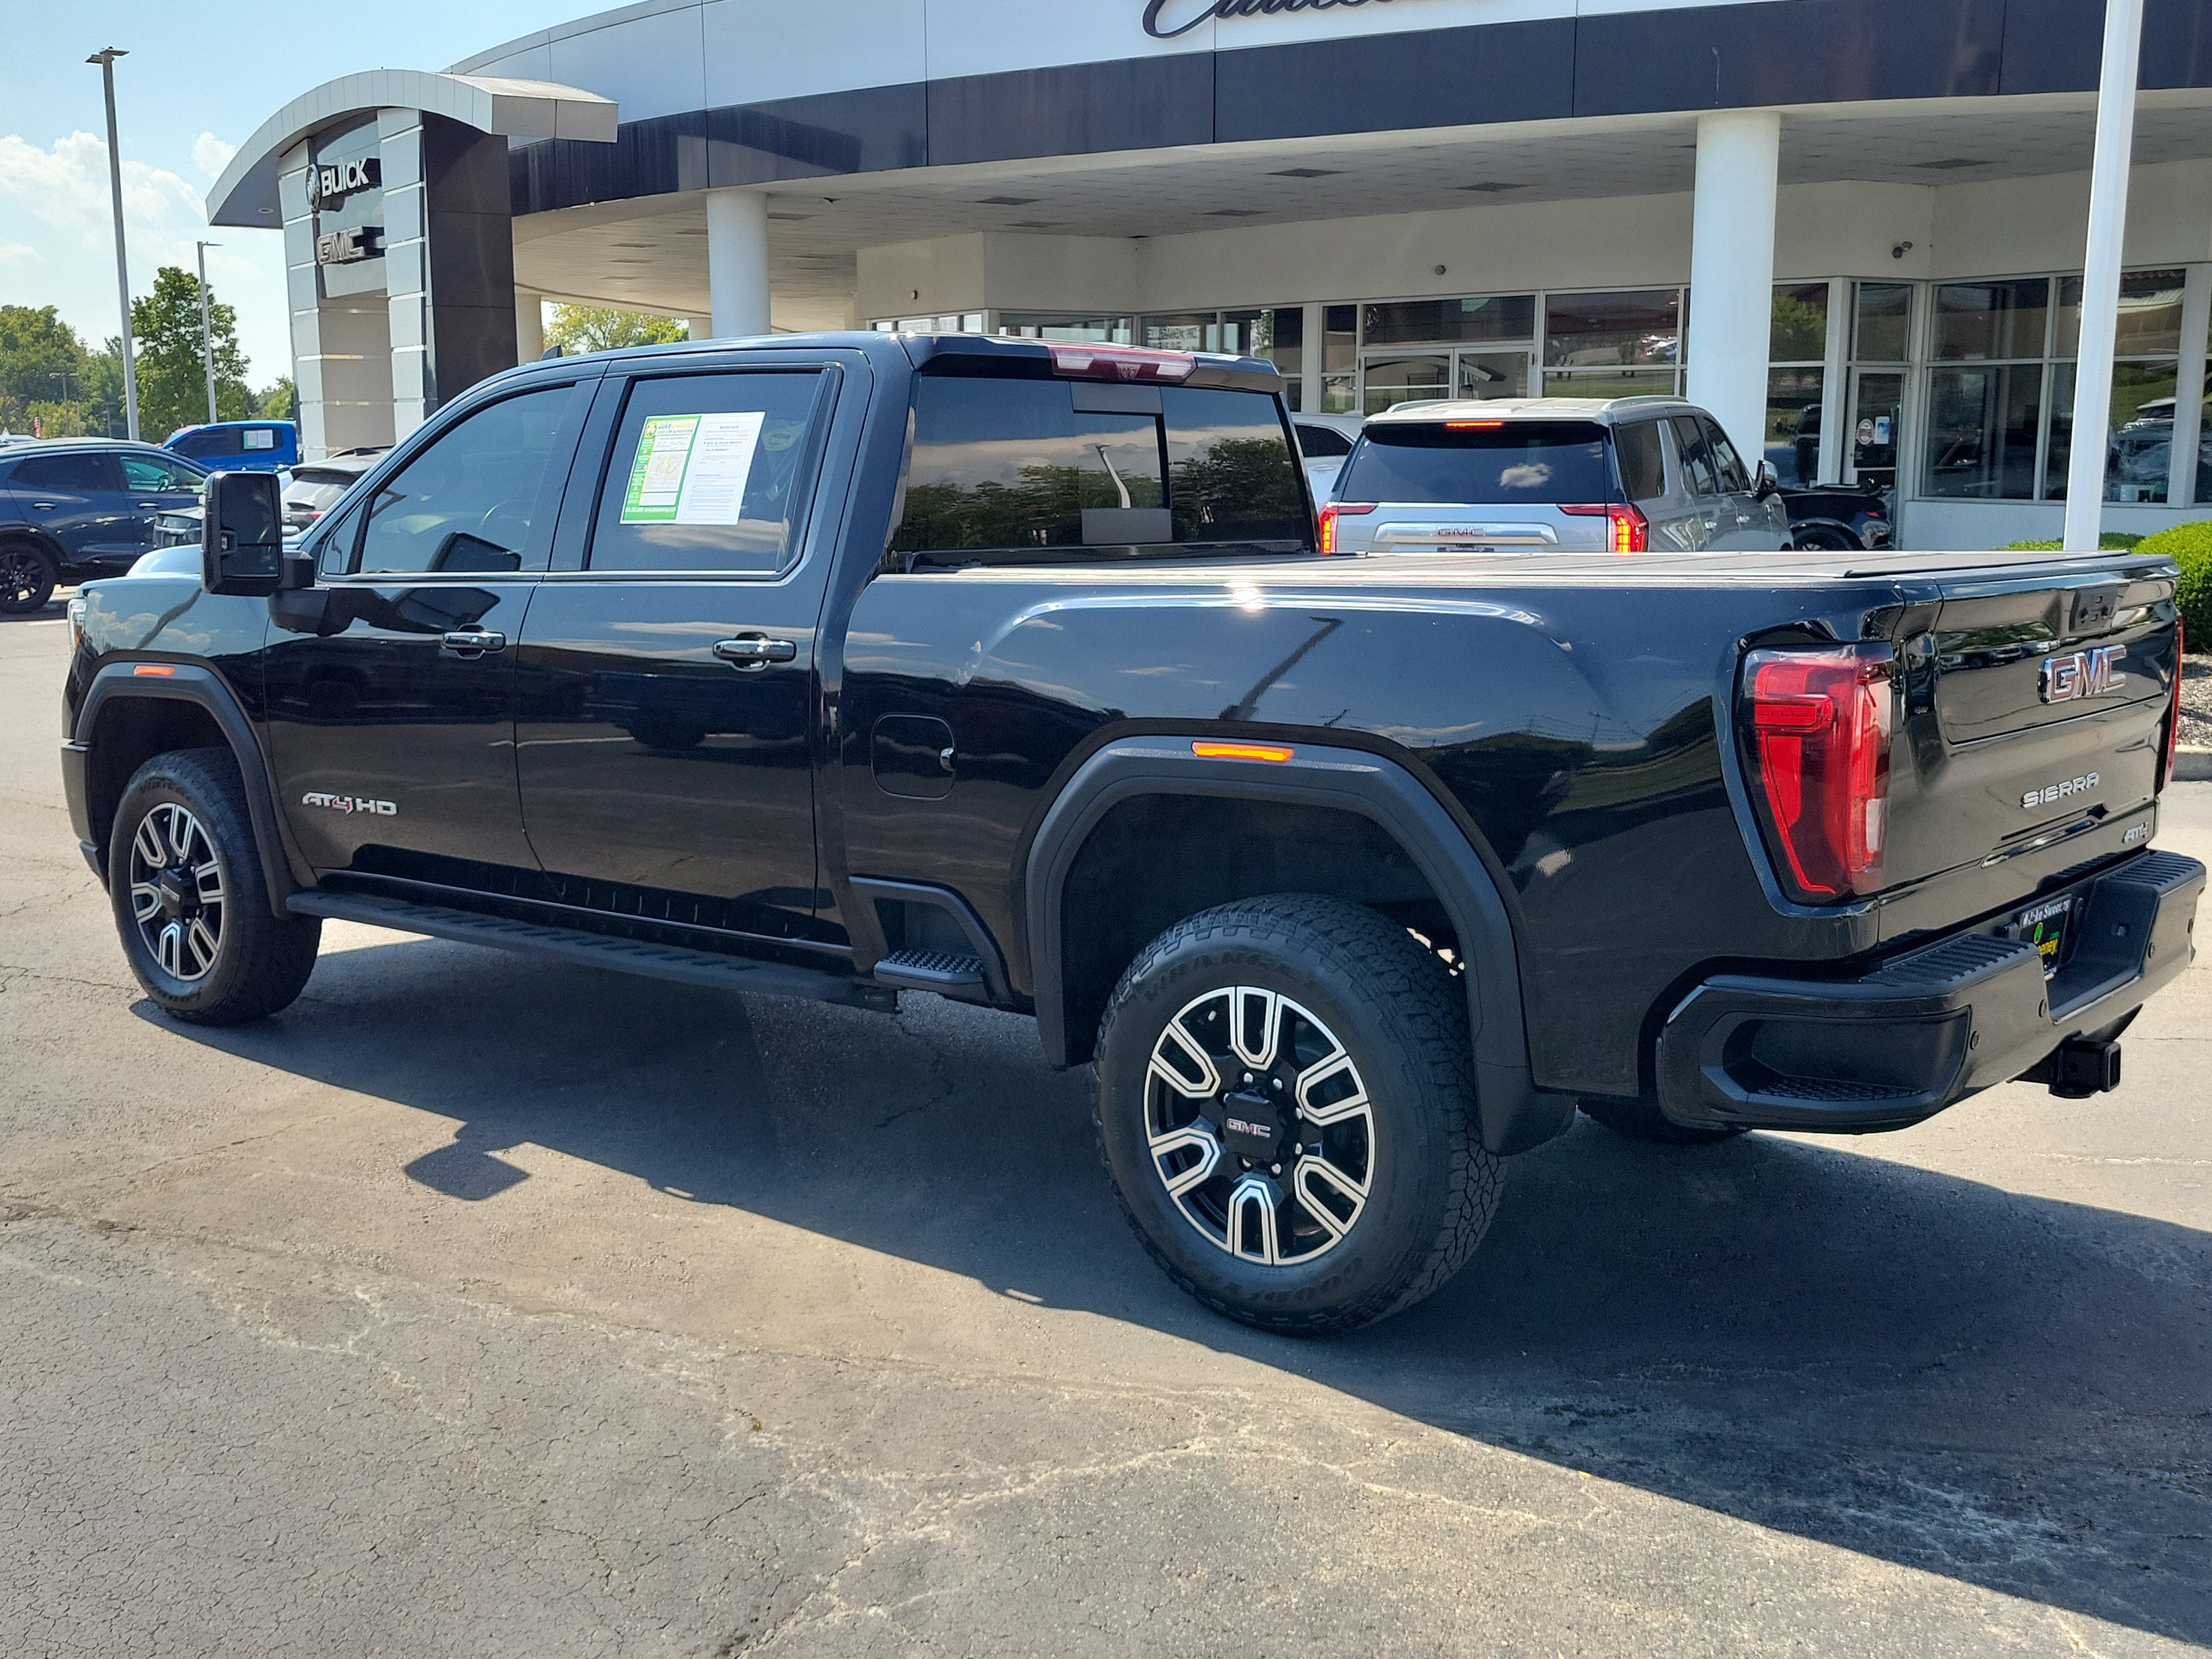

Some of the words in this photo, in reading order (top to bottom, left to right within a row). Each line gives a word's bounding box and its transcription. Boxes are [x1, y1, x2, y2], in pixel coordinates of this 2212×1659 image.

[321, 157, 369, 197] BUICK
[317, 225, 365, 266] GMC
[1437, 526, 1486, 538] GMC
[2037, 644, 2126, 704] GMC
[2021, 771, 2100, 809] SIERRA
[1227, 1118, 1271, 1137] GMC
